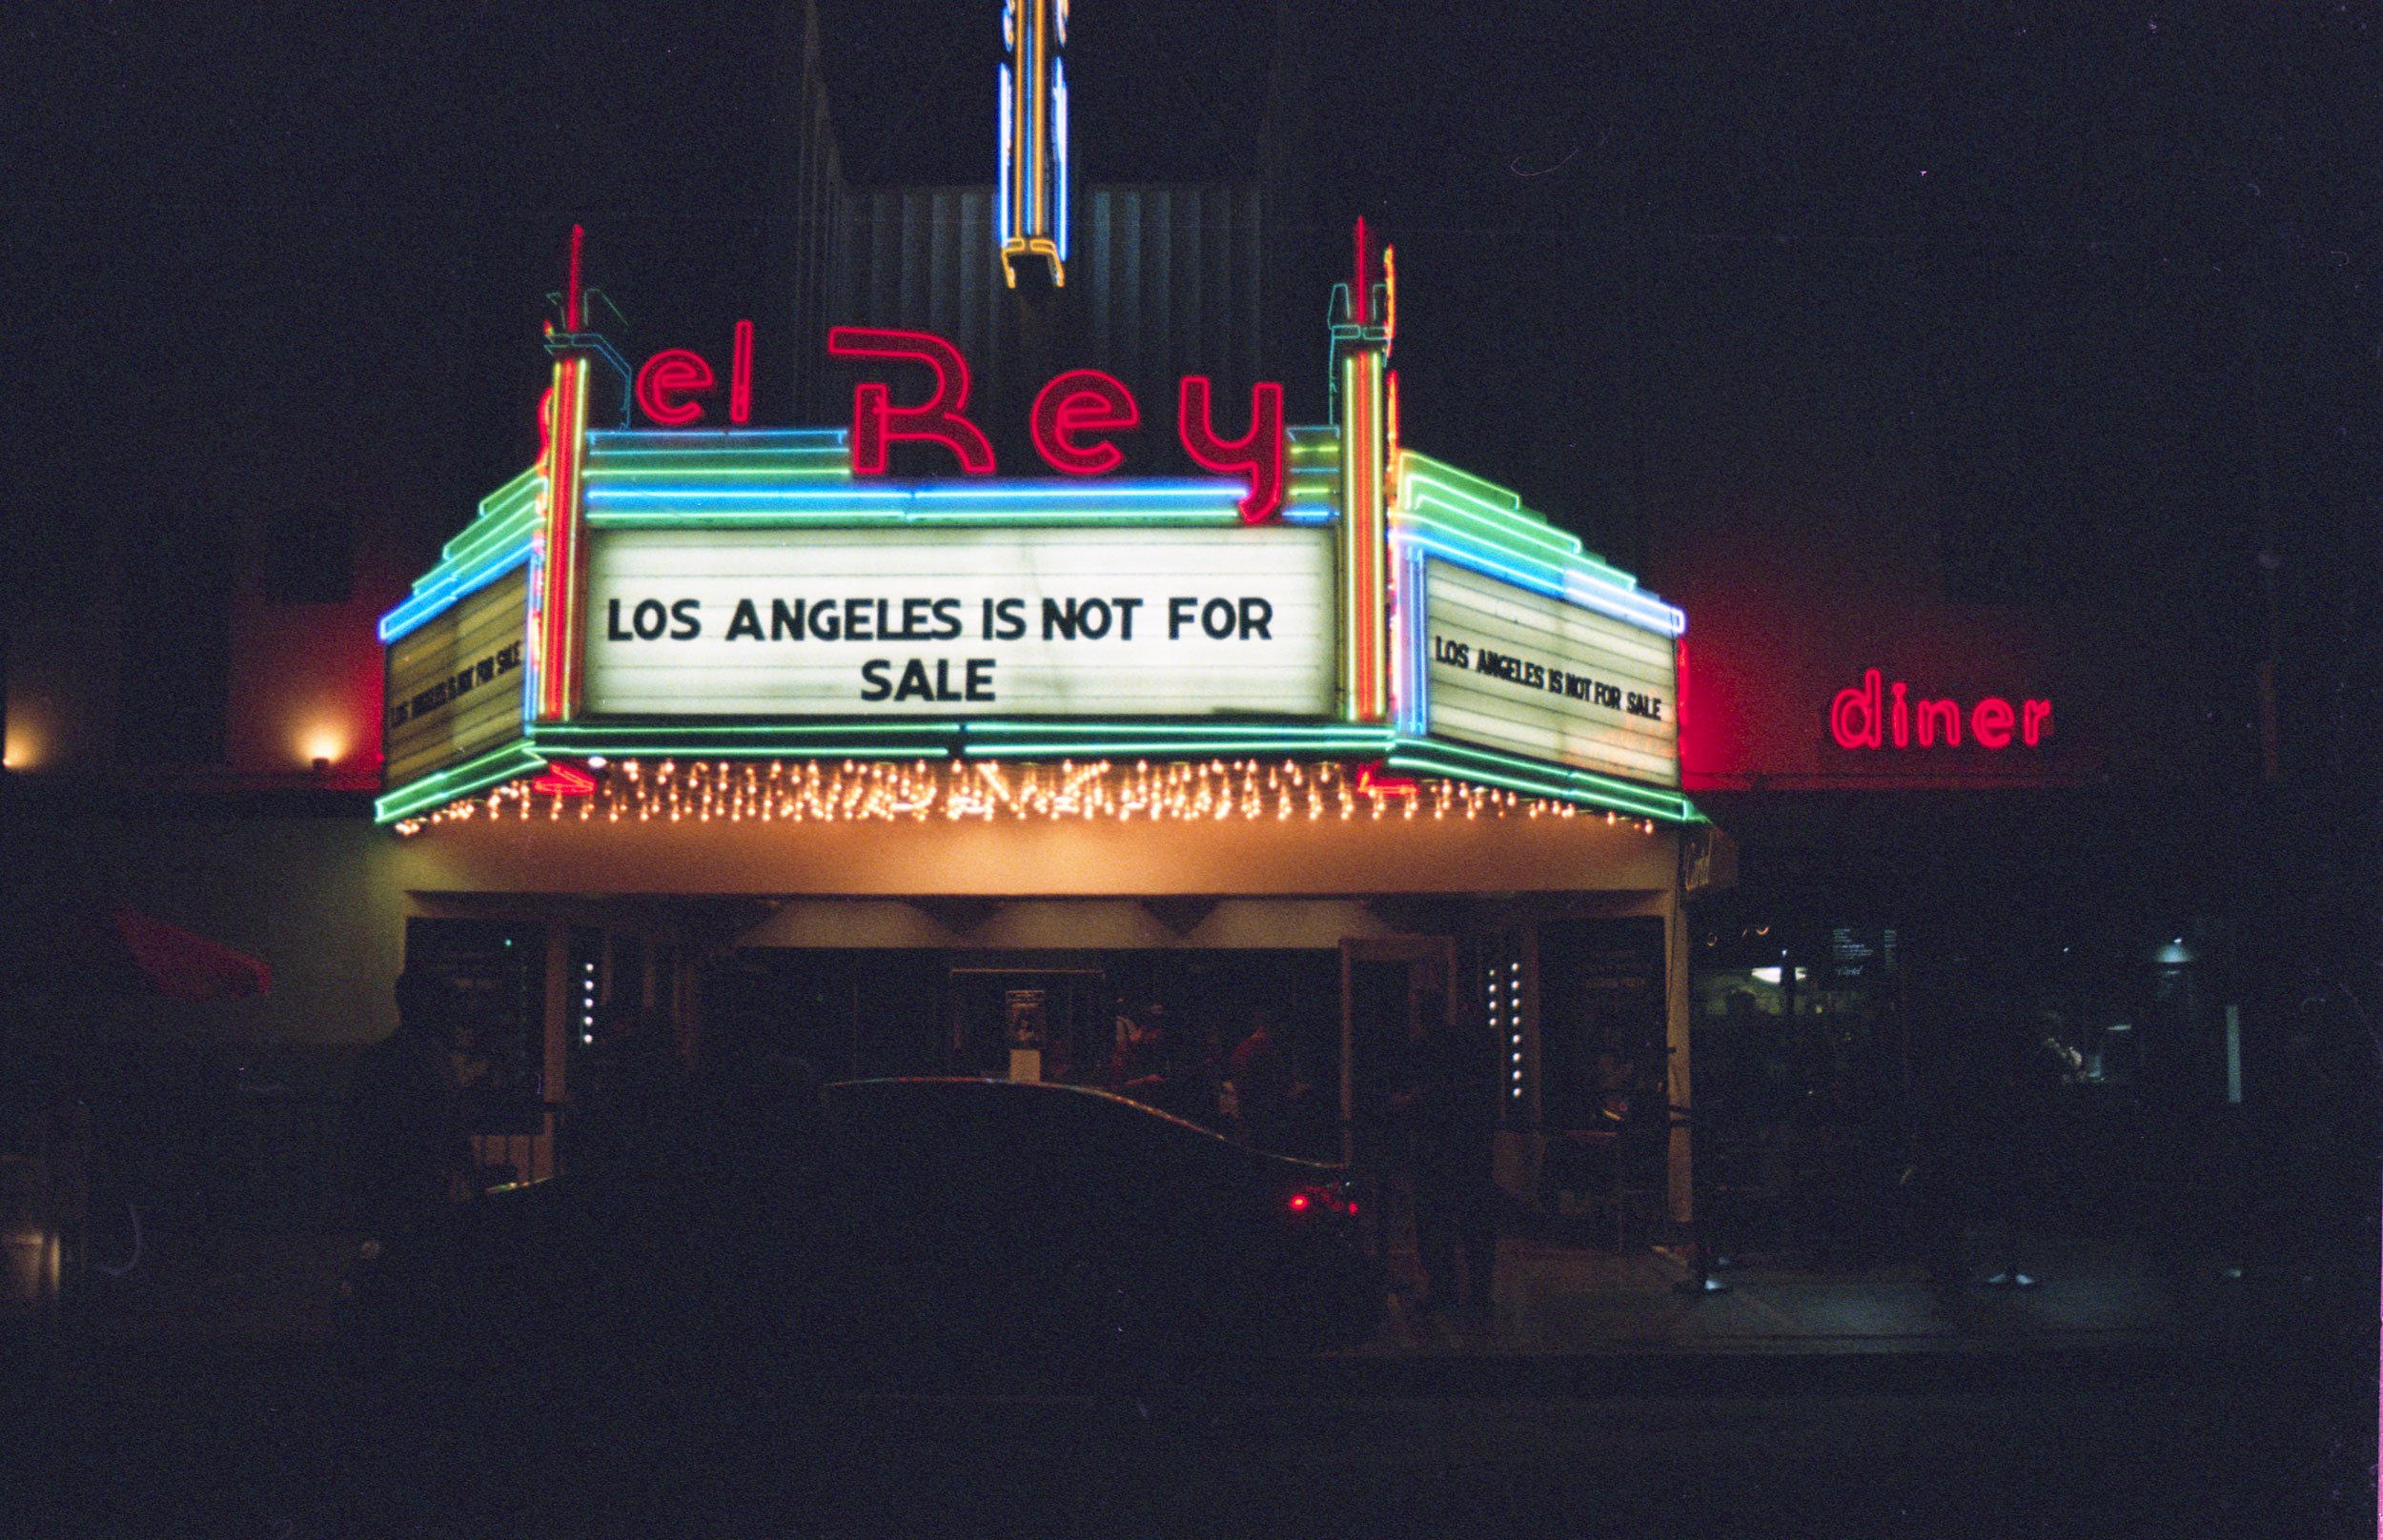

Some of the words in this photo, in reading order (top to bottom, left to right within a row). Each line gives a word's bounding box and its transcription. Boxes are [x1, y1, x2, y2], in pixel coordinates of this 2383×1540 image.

[636, 319, 754, 425] el
[826, 326, 1284, 523] Rey
[607, 597, 703, 642] LOS
[723, 597, 964, 642] ANGELES
[982, 597, 1028, 641] IS
[1041, 597, 1144, 641] NOT
[1168, 597, 1273, 641] FOR
[860, 658, 997, 702] SALE
[1436, 636, 1469, 669] LOS
[1477, 648, 1544, 689] ANGELES
[1547, 668, 1564, 695] IS
[1564, 672, 1592, 702] NOT
[1594, 680, 1621, 710] FOR
[1626, 691, 1661, 720] SALE
[1830, 668, 2051, 750] diner
